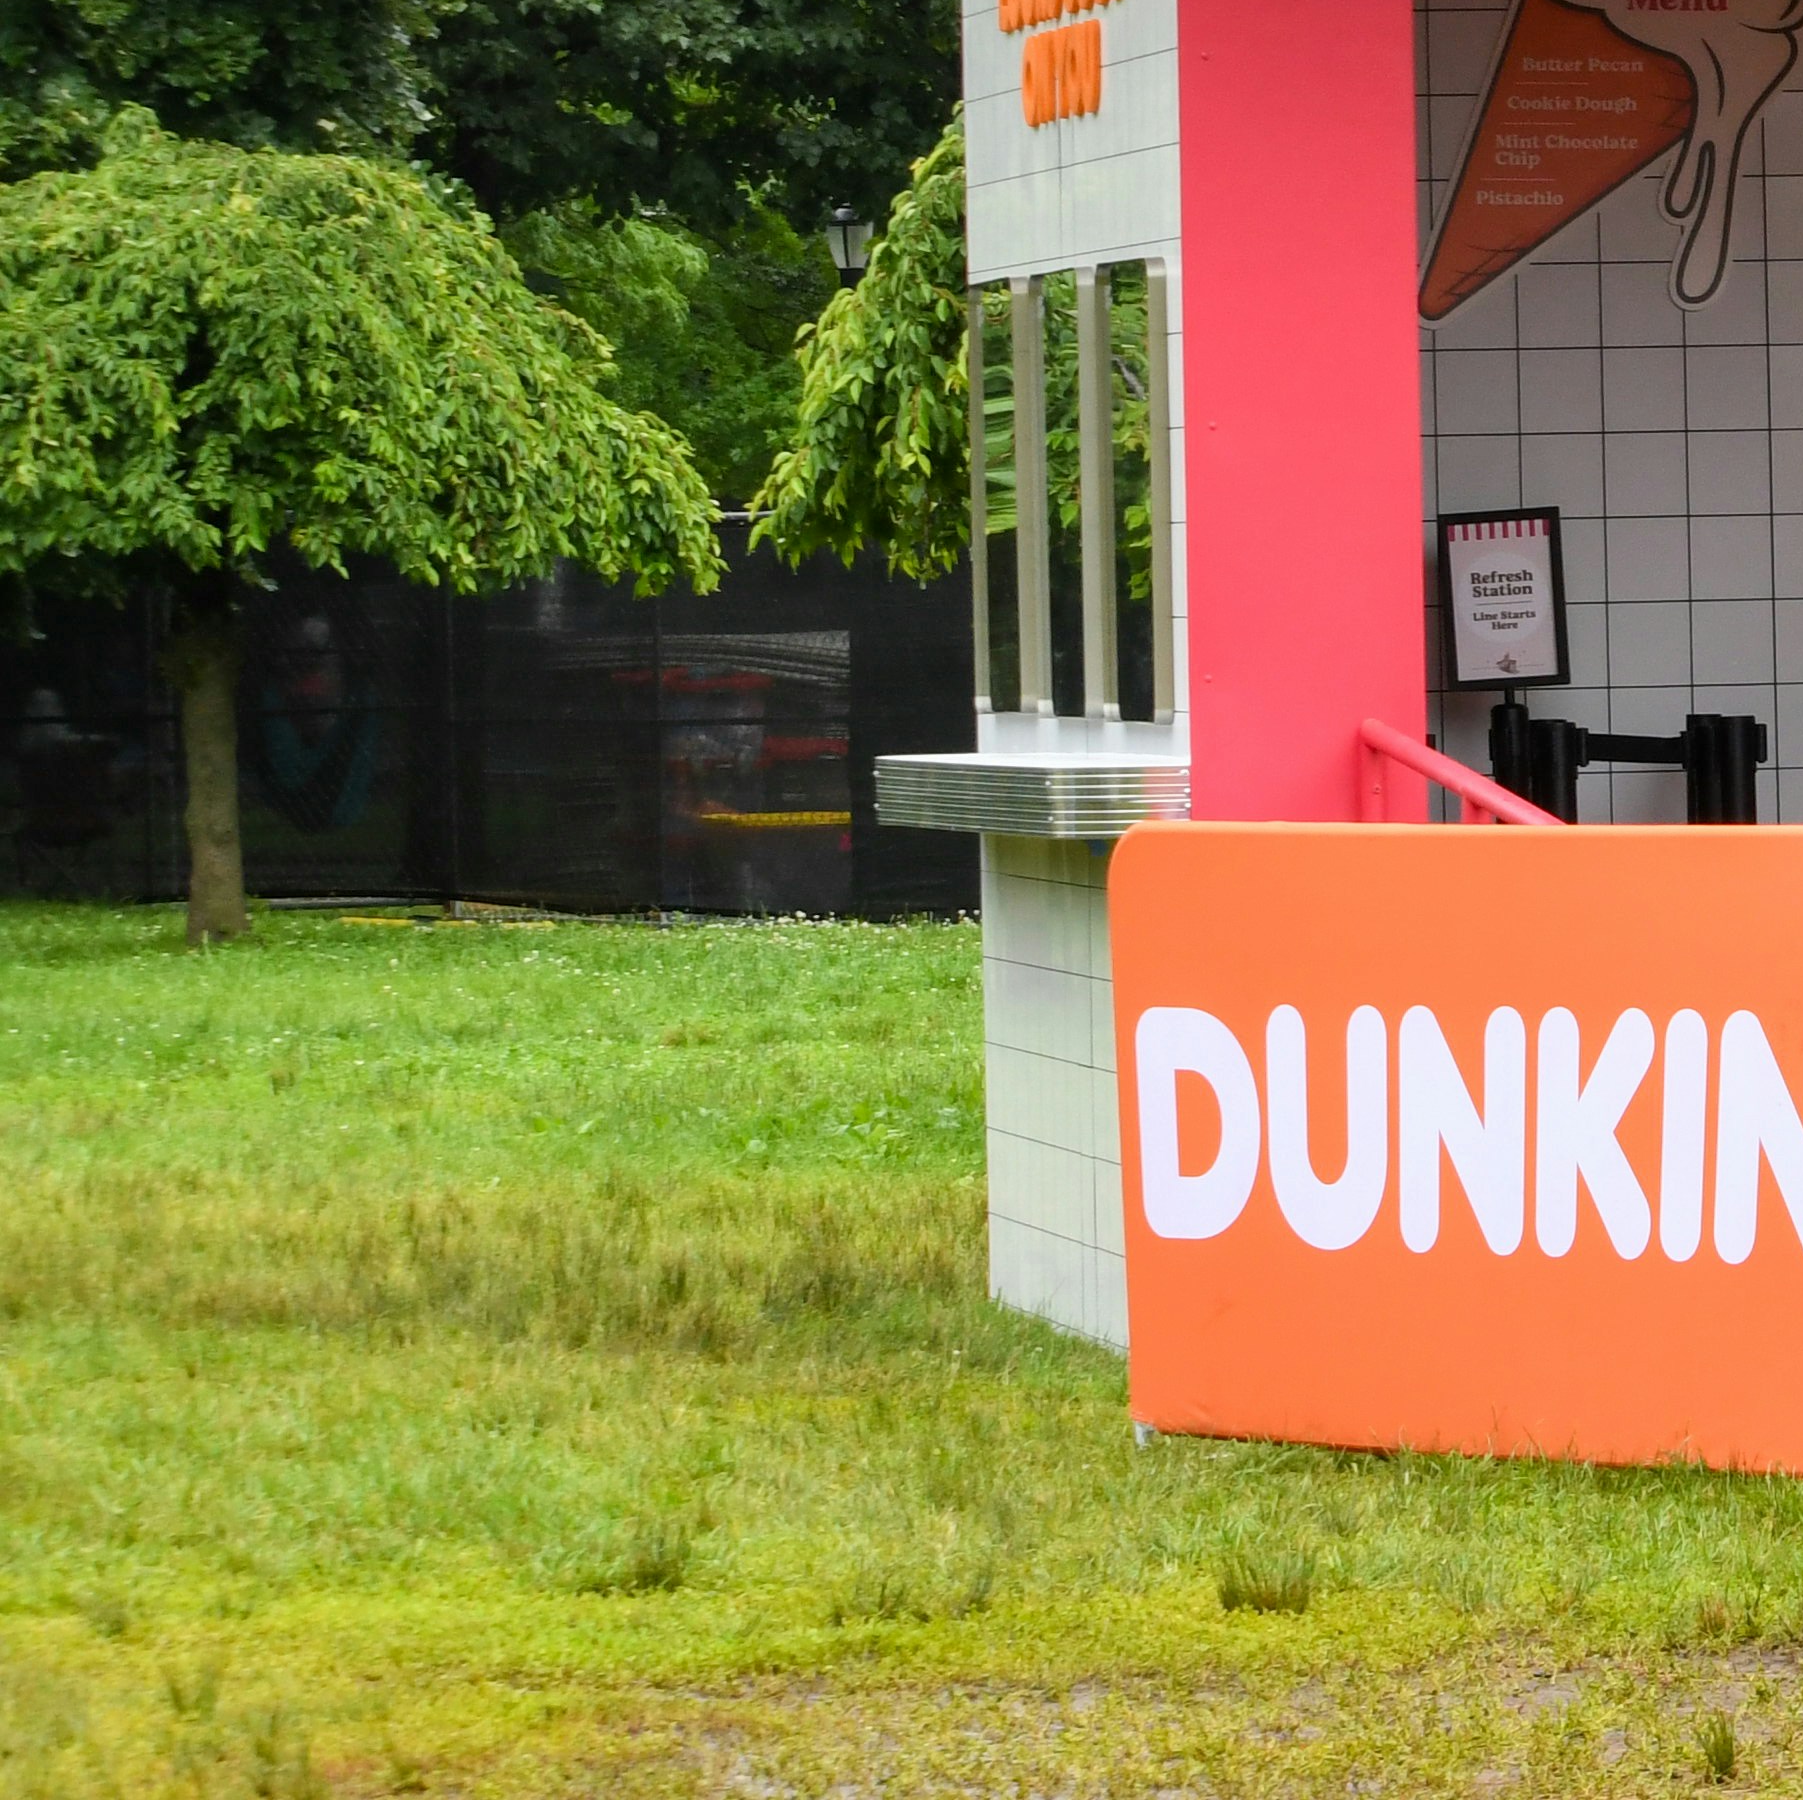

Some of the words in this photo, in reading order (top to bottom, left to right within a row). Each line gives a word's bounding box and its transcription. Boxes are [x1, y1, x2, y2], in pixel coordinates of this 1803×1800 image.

[1523, 57, 1583, 72] Butter
[1588, 57, 1644, 72] Pecan
[1507, 96, 1570, 111] Cookie
[1576, 96, 1637, 114] Dough
[1495, 134, 1539, 149] Mint
[1545, 134, 1639, 150] Chocolate
[1495, 151, 1541, 169] Chip
[1476, 190, 1564, 206] Pistachio
[1471, 570, 1533, 585] Refresh
[1472, 584, 1533, 598] Station
[1473, 611, 1498, 622] Line
[1501, 609, 1536, 620] Starts
[1492, 621, 1518, 631] Here
